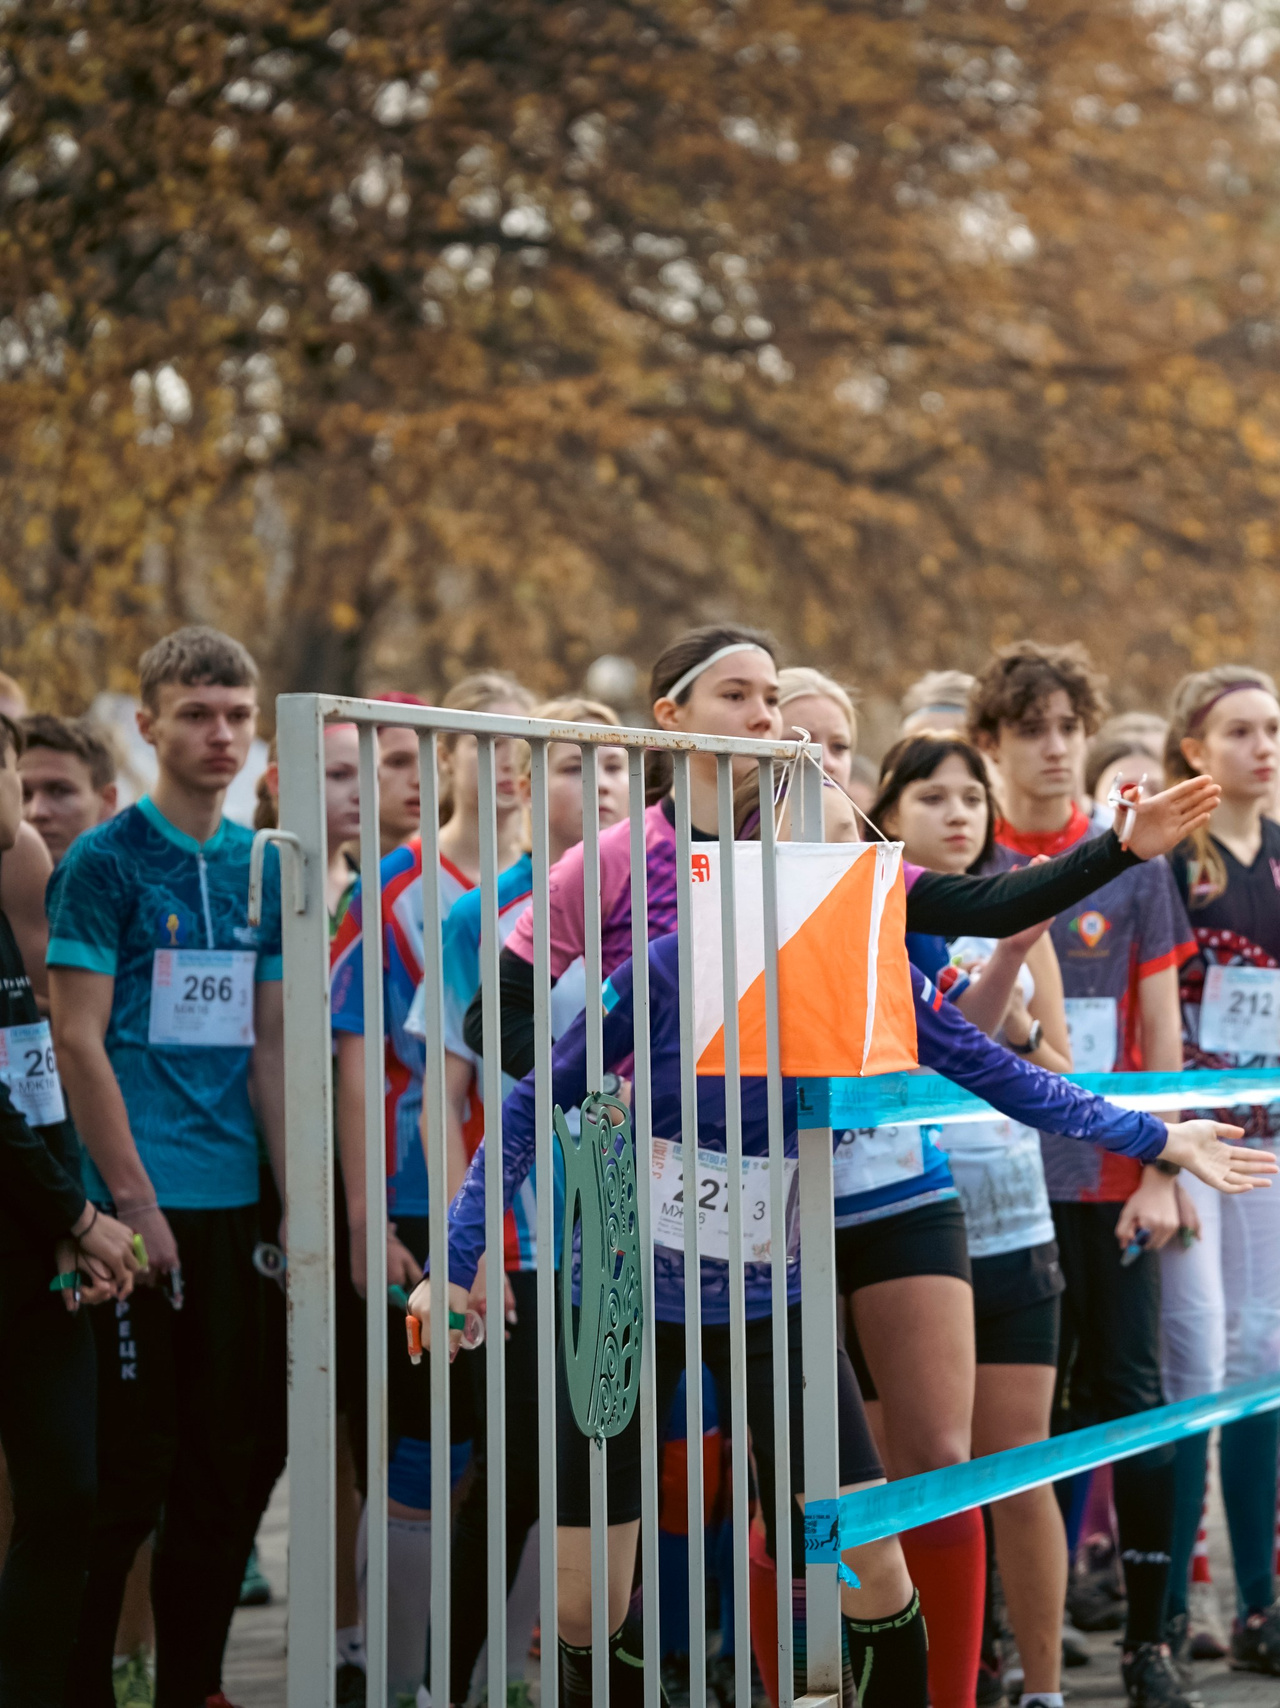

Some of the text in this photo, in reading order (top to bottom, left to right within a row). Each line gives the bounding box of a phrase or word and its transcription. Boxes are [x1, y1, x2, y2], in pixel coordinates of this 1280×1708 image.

[183, 975, 232, 1003] 266
[1229, 990, 1274, 1017] 212
[652, 1140, 668, 1169] ЭТАП
[661, 1202, 706, 1225] МЖ6
[753, 1201, 766, 1221] 3
